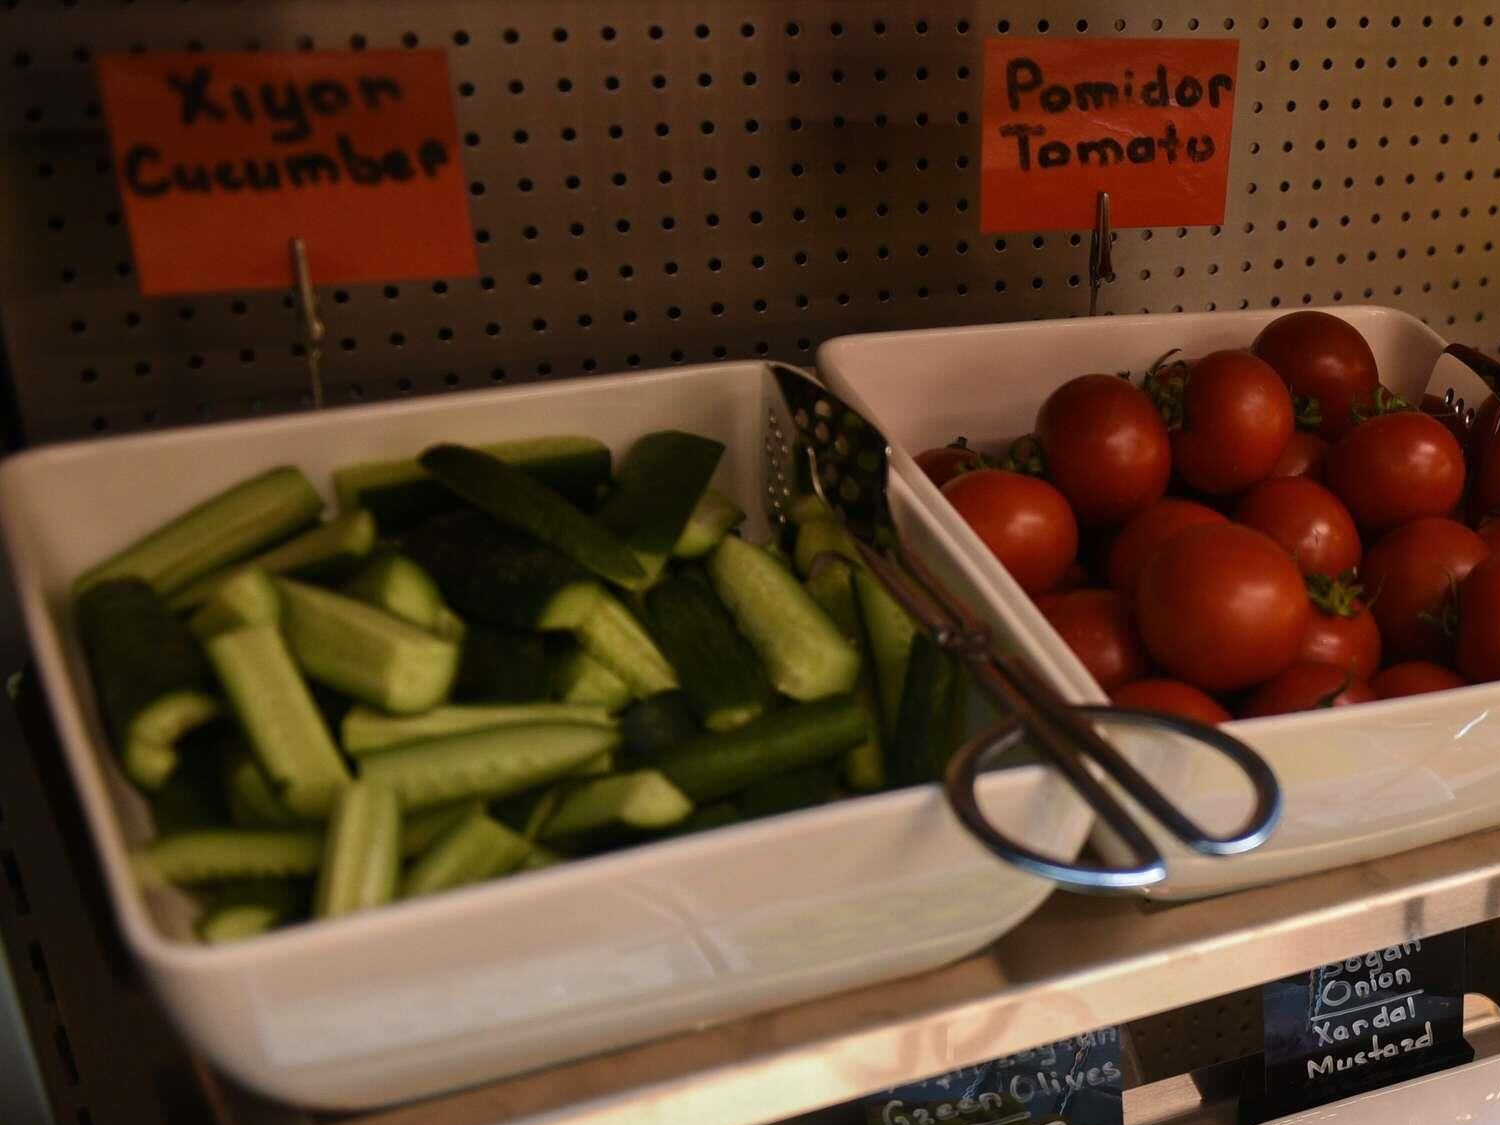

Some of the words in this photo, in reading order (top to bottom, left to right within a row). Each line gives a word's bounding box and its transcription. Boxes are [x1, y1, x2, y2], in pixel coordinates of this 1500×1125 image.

[1005, 57, 1234, 113] Pomidor
[125, 133, 448, 197] Cucumber
[999, 119, 1216, 172] Tomato
[1321, 967, 1412, 1007] Onion
[1312, 996, 1416, 1047] Xardal
[1009, 1060, 1121, 1102] Olives
